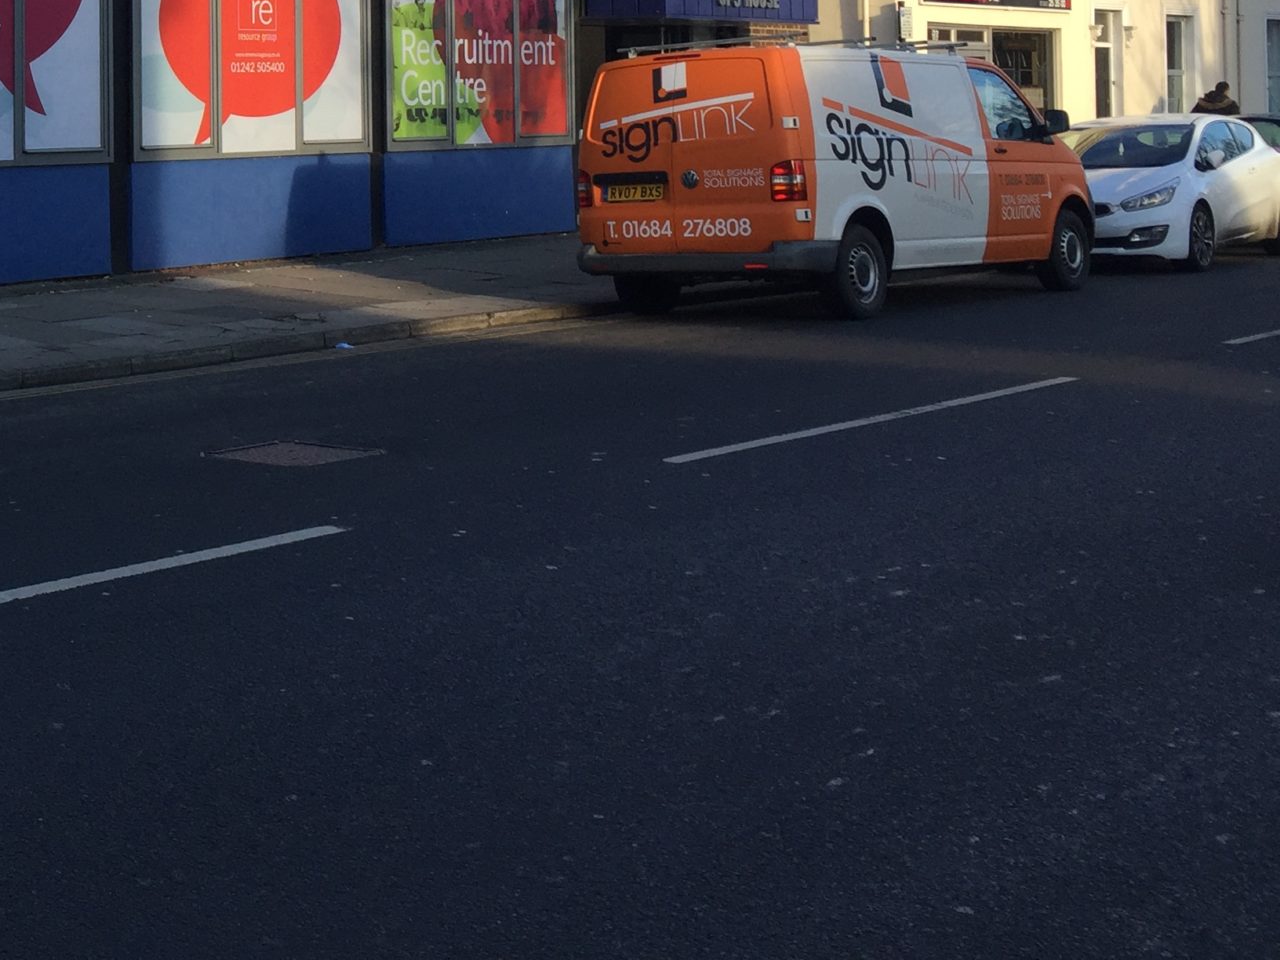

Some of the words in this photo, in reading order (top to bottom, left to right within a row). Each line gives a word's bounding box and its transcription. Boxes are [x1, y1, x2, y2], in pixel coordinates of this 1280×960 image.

[251, 0, 273, 25] re
[401, 28, 556, 67] Recruitment
[230, 62, 255, 73] 01242
[256, 62, 285, 73] 505400
[400, 69, 487, 106] Centre
[703, 169, 724, 178] TOTAL
[726, 167, 764, 177] SIGNAGE
[703, 176, 765, 189] SOLUTIONS
[609, 187, 638, 200] RV07
[640, 186, 662, 199] BXS
[1001, 204, 1042, 221] SOLUTIONS
[622, 220, 672, 238] 01684
[683, 218, 752, 237] 276808
